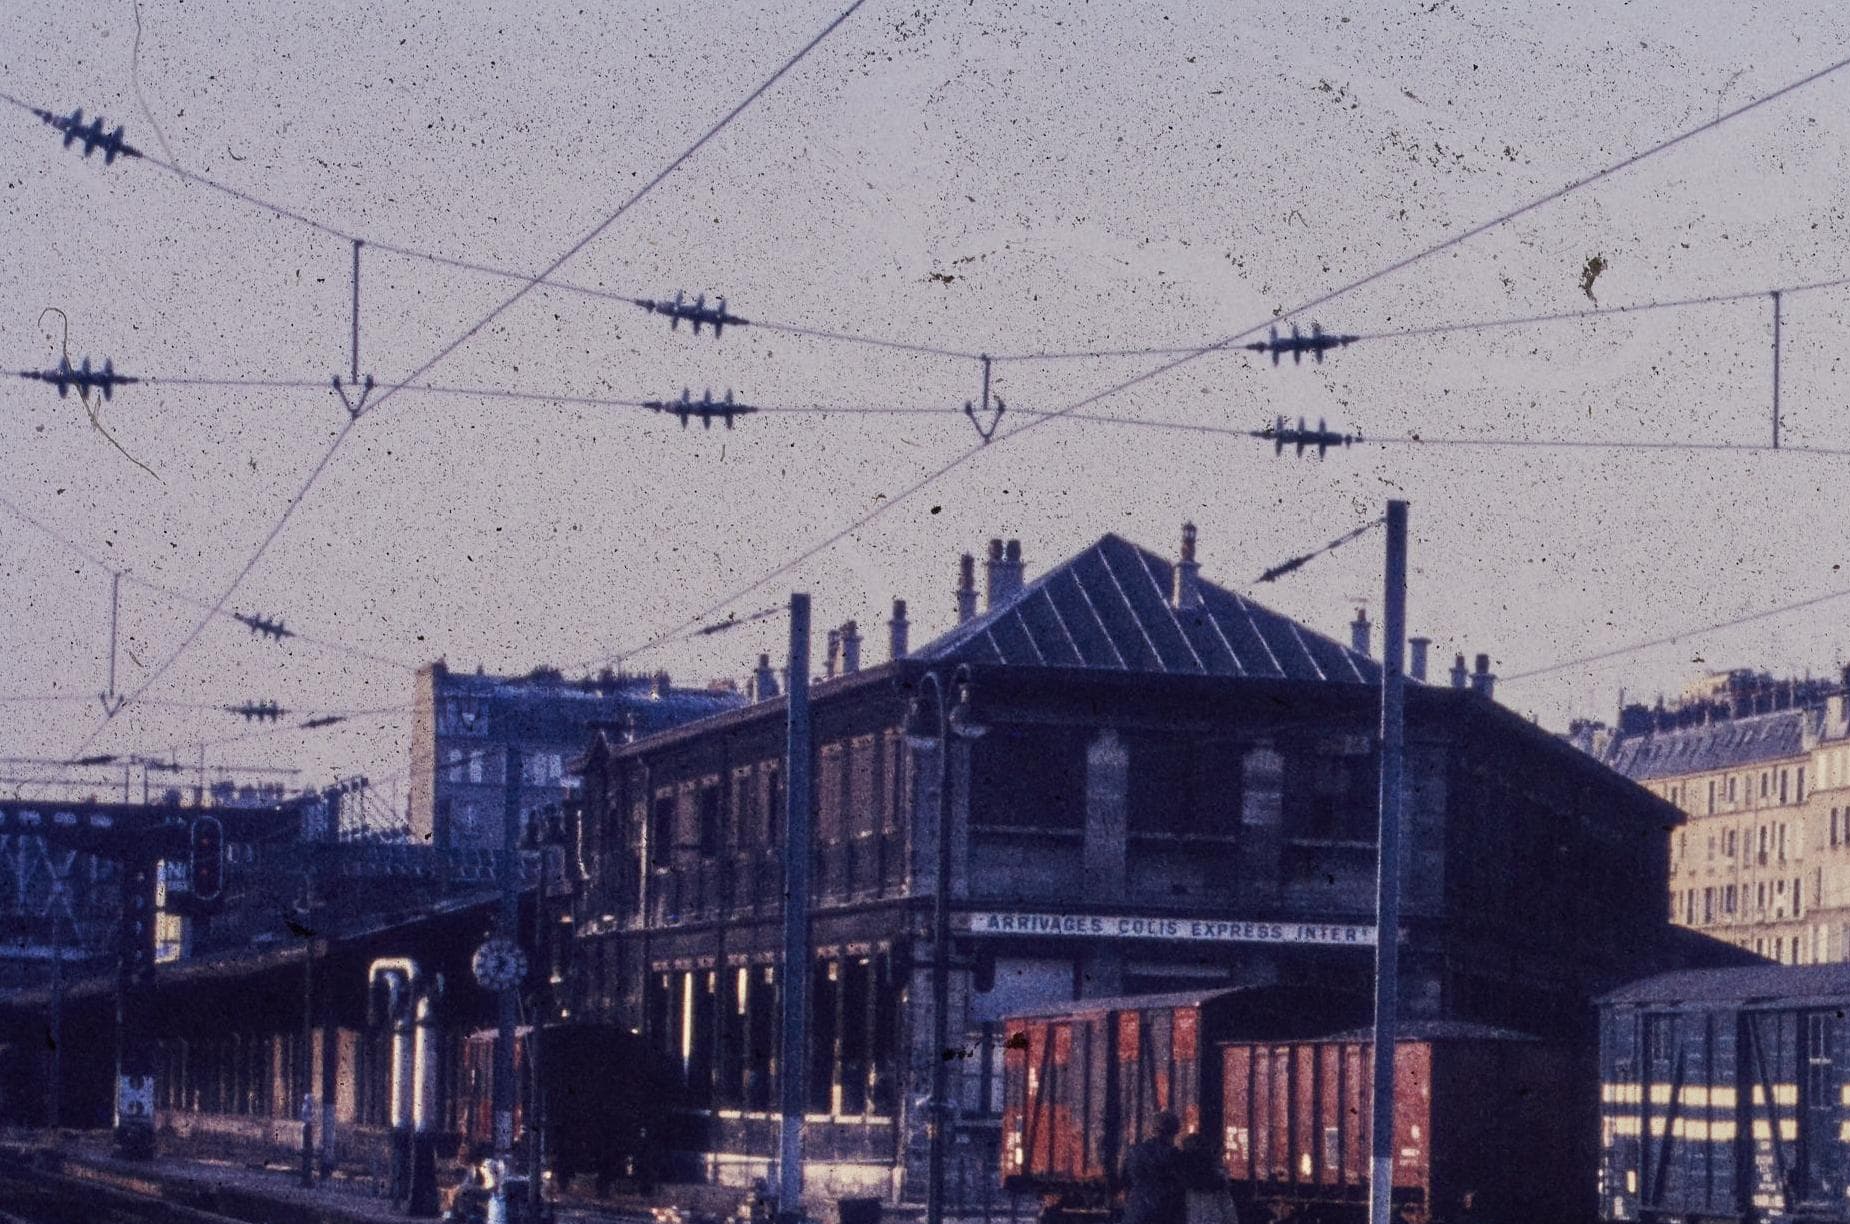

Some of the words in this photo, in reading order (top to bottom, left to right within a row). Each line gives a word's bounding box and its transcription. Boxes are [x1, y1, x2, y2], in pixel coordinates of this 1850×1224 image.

[987, 914, 1103, 933] ARRIVAGES
[1118, 919, 1178, 935] COLIS
[1191, 923, 1283, 939] EXPRESS
